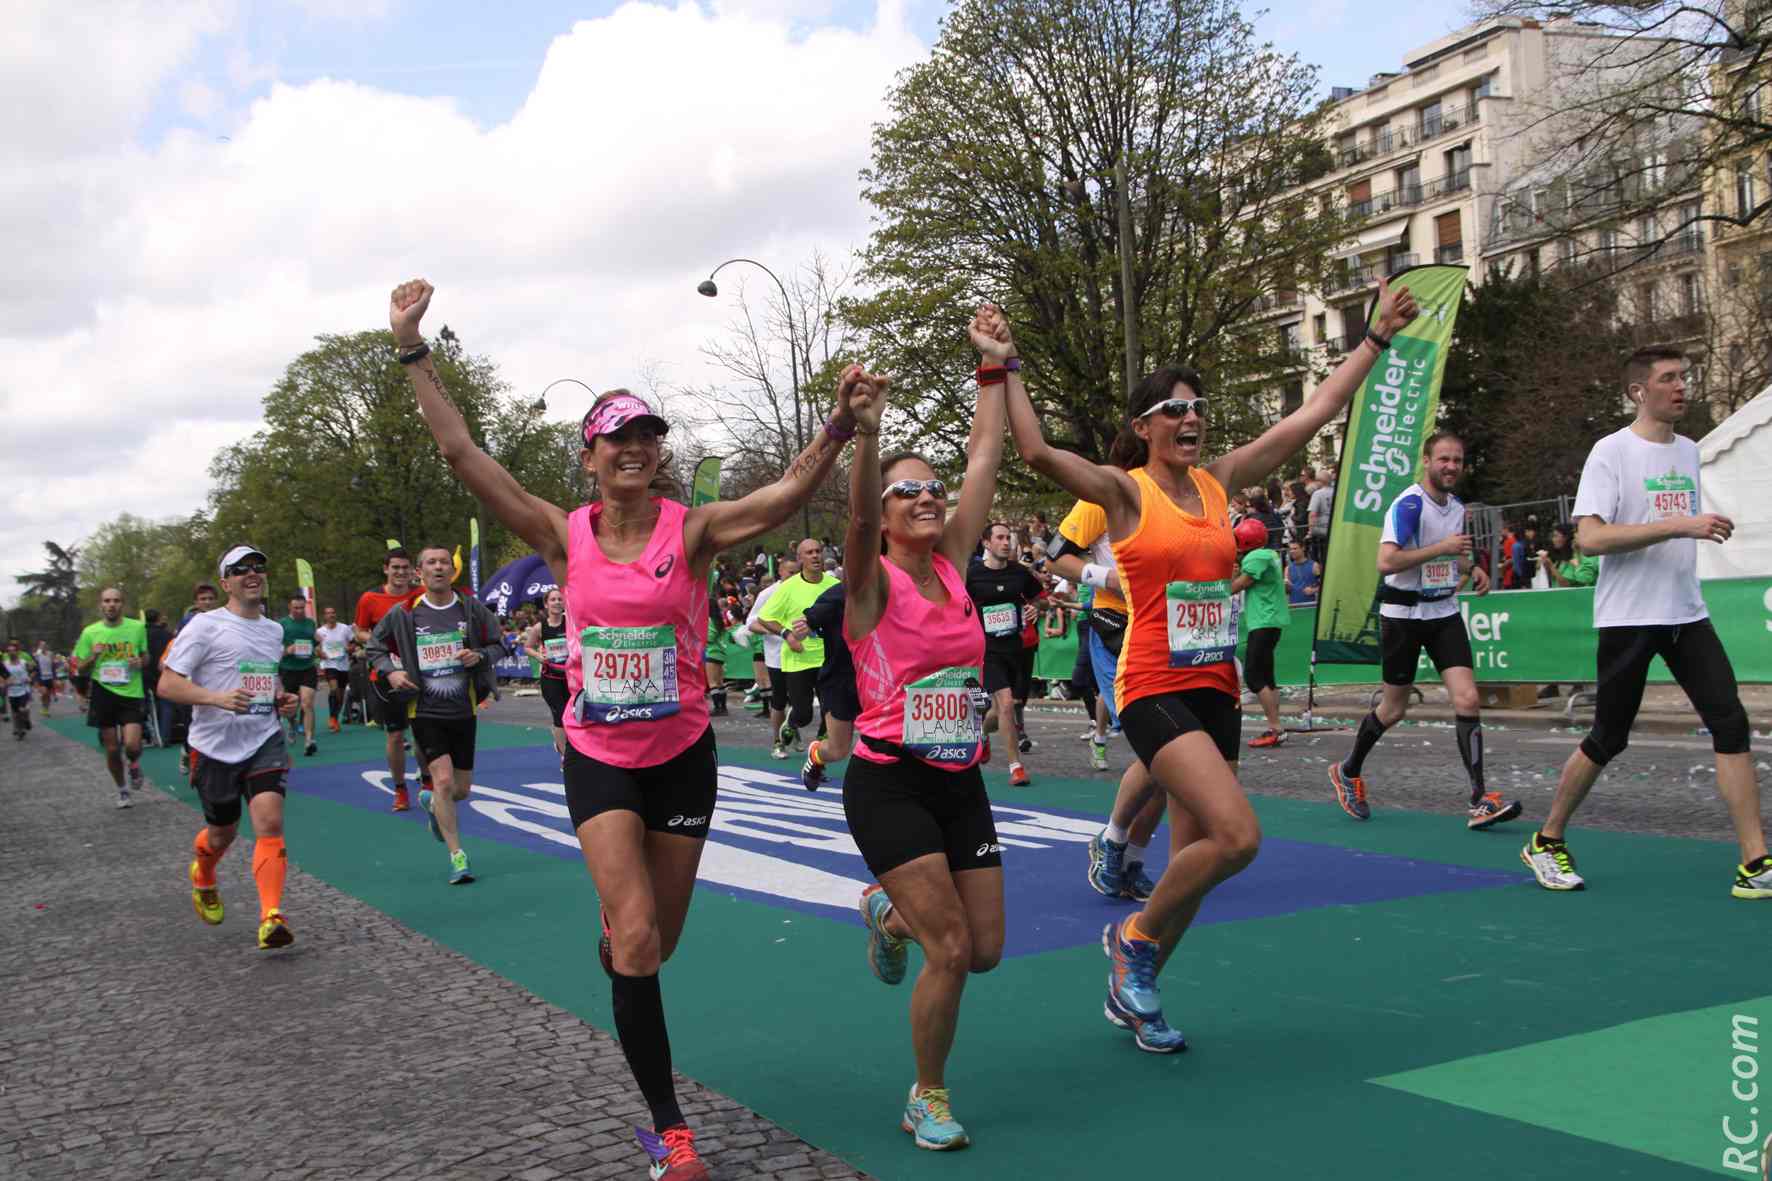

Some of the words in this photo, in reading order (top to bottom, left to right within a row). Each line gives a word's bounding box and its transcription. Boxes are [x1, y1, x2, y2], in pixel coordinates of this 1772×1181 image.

[1394, 359, 1425, 447] Electric
[1354, 348, 1408, 512] Schneider
[1655, 493, 1688, 511] 45743
[1176, 603, 1222, 629] 29761
[598, 630, 659, 641] Schneider
[594, 652, 650, 680] 29731
[599, 679, 660, 694] CLARA
[912, 693, 968, 721] 35806
[923, 720, 977, 735] LAURA
